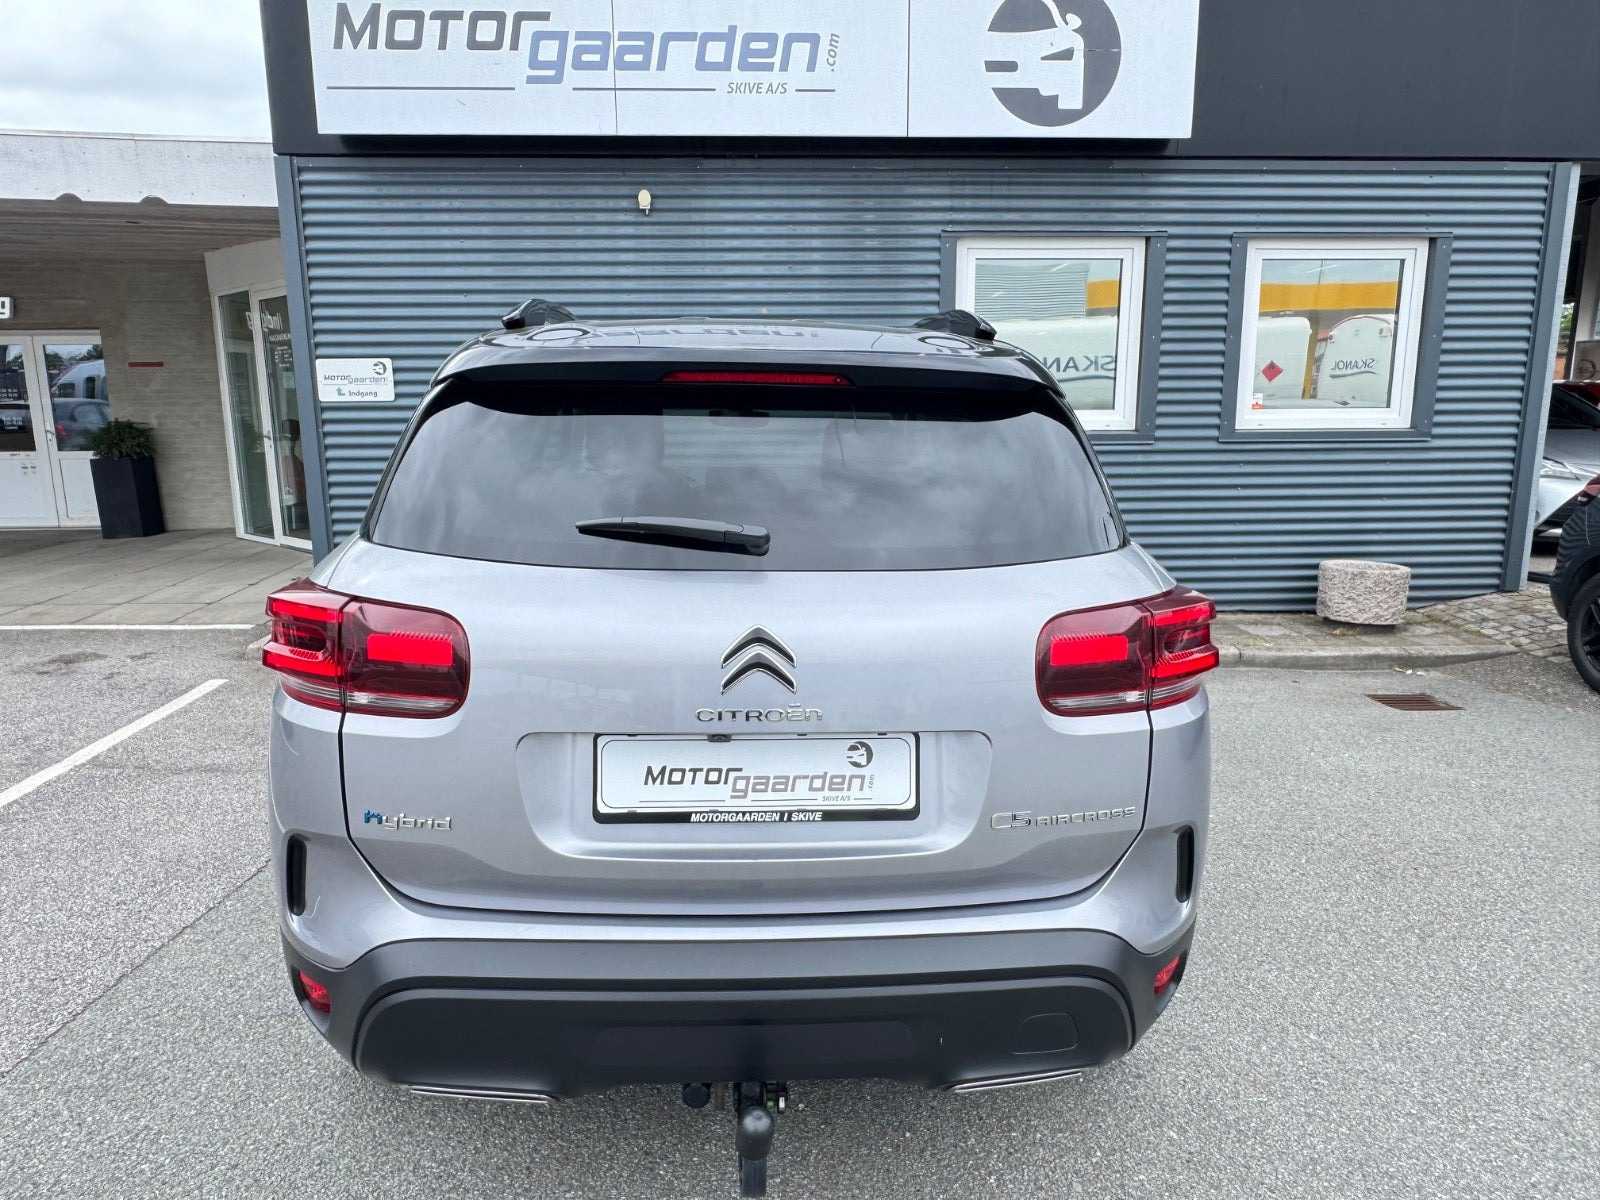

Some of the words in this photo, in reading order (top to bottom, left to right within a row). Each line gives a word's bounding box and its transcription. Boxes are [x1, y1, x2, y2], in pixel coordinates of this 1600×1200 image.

[826, 32, 841, 72] .com
[727, 82, 763, 94] SKIVE
[765, 82, 788, 95] A/S
[348, 390, 378, 398] Indgang
[822, 795, 839, 803] SKIVE
[690, 812, 780, 823] MOTORGAARDEN
[791, 811, 823, 822] SKIVE
[991, 810, 1032, 829] C5
[1036, 806, 1136, 827] AIRCROSS
